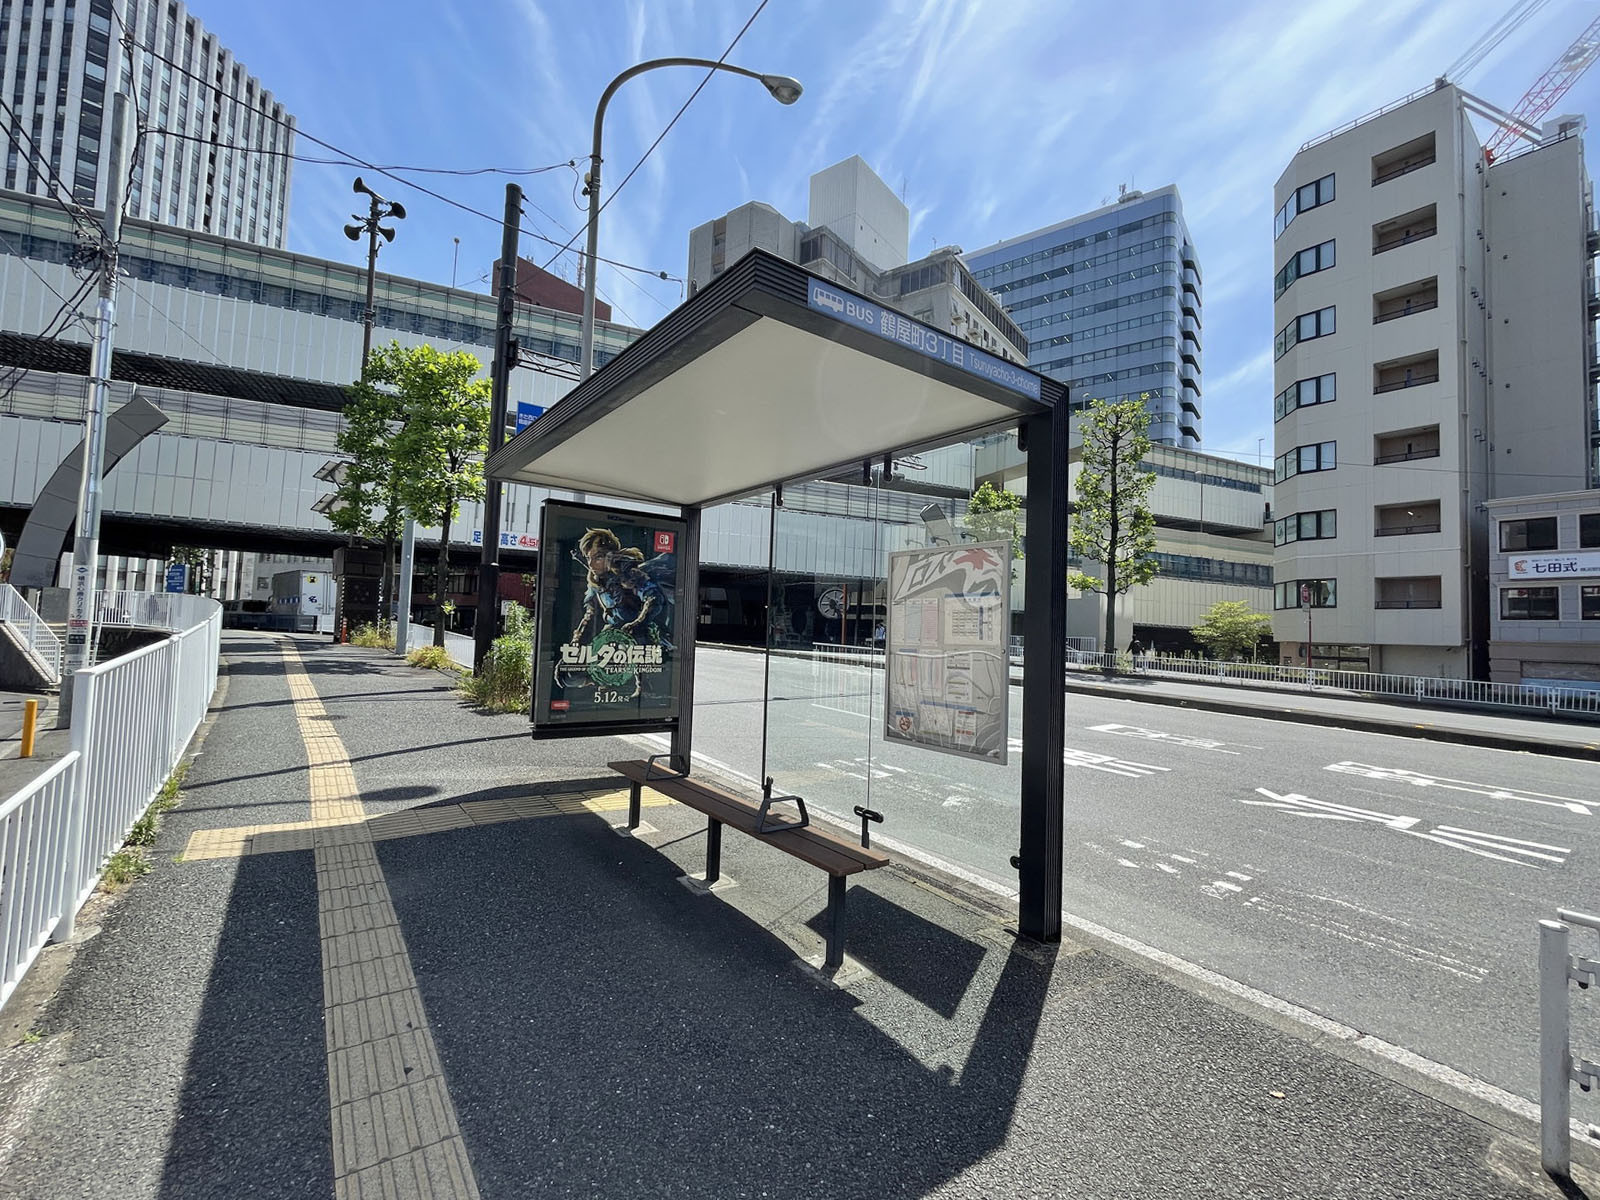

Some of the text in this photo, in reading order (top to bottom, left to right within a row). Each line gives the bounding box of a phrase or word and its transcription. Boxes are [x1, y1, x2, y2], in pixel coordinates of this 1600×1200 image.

[846, 302, 1039, 394] BUS 鶴屋町3丁目 Tsuruyacho-3-chome
[1532, 562, 1578, 573] 七田式
[560, 643, 663, 668] ゼルダの伝説
